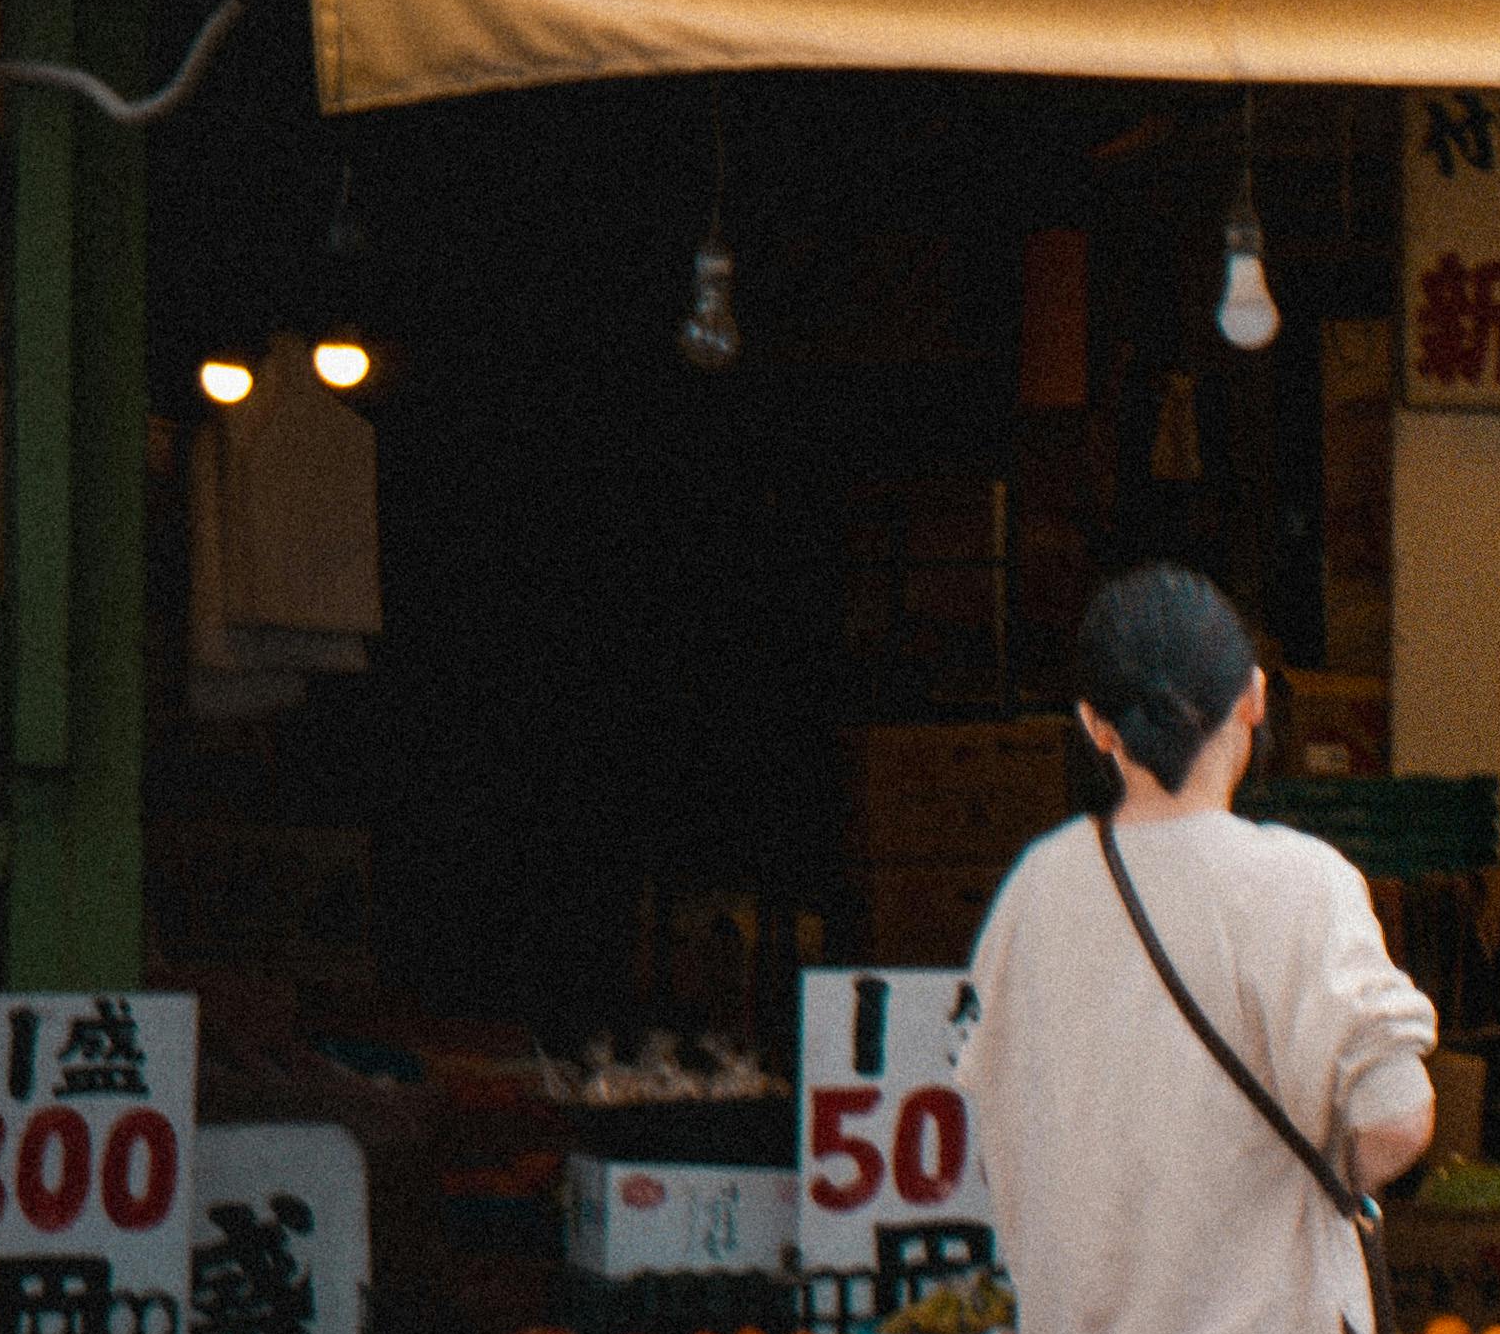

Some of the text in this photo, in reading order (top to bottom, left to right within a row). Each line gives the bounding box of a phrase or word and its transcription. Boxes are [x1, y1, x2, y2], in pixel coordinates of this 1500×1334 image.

[7, 996, 151, 1102] 1盛
[852, 974, 981, 1078] 1
[808, 1084, 987, 1213] 50
